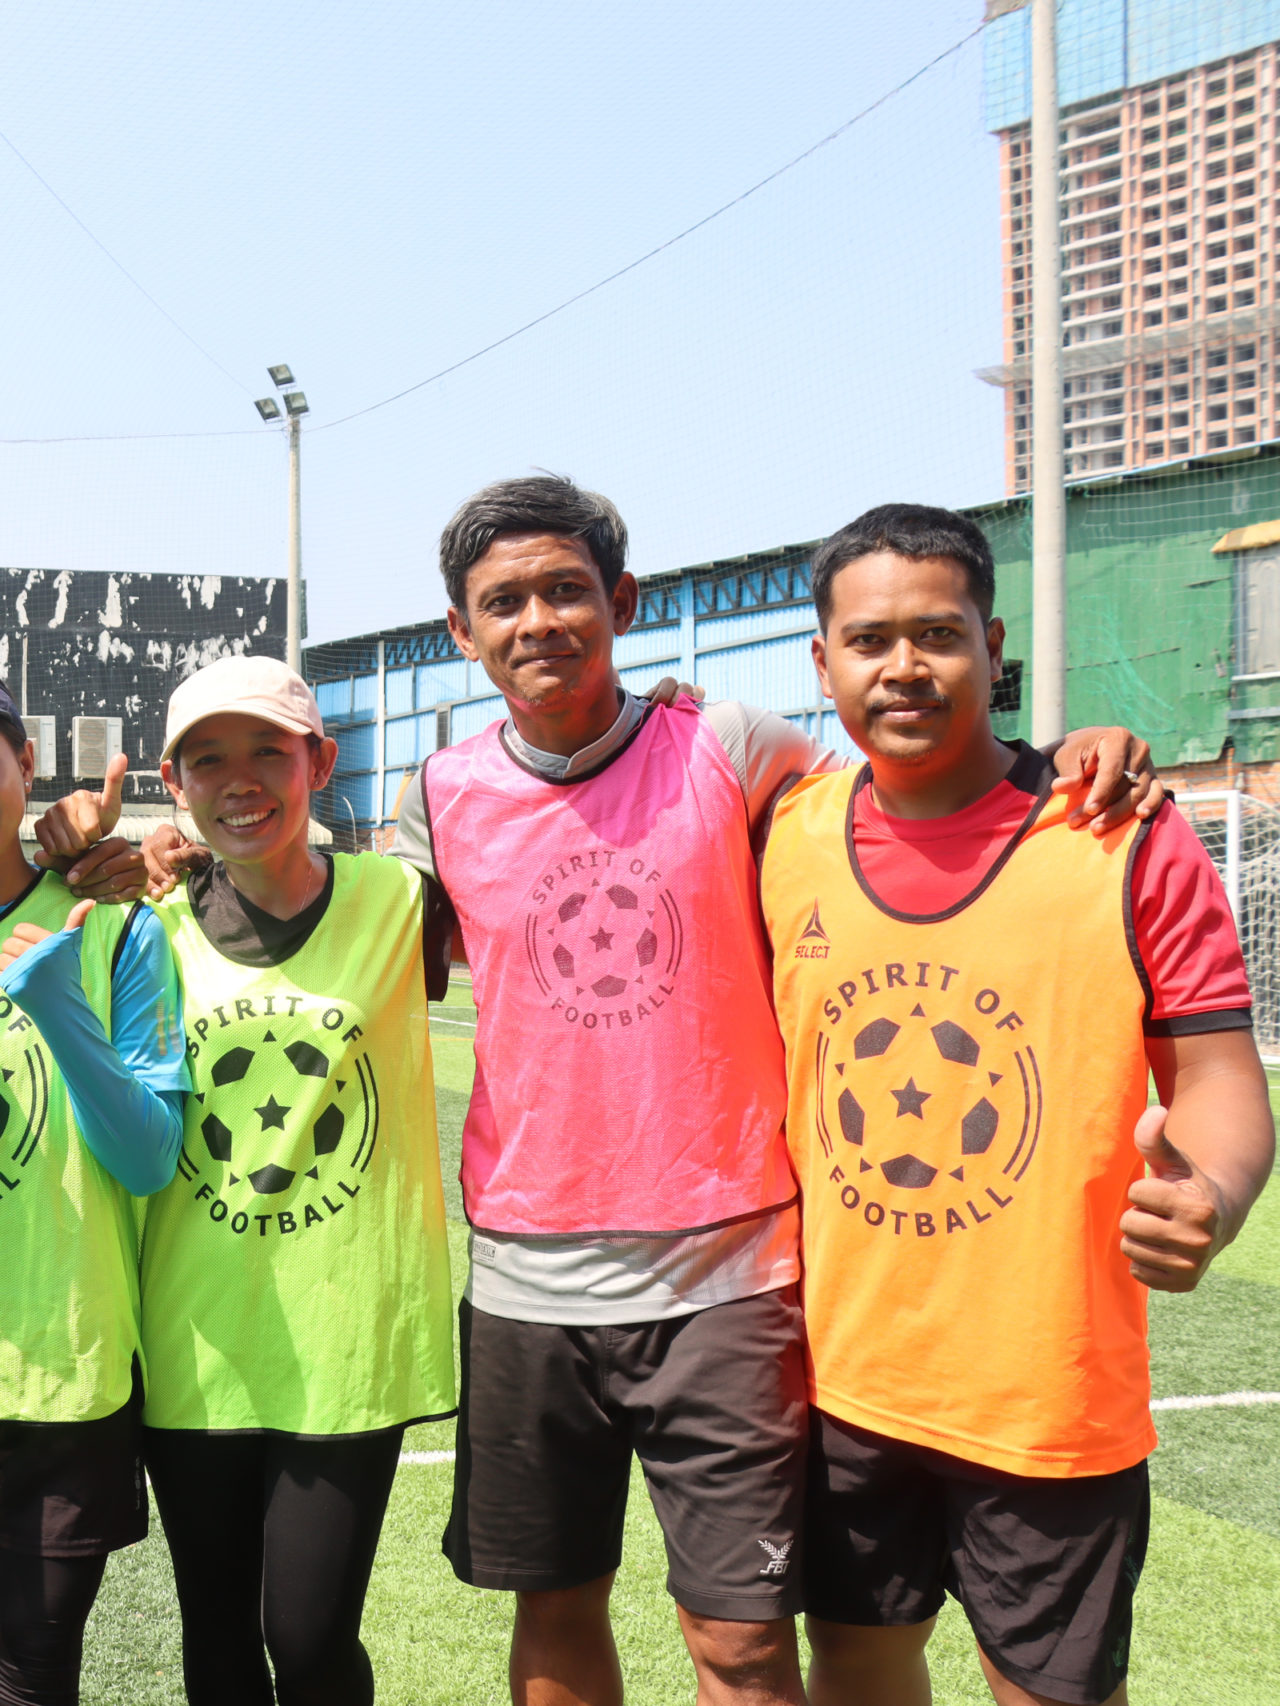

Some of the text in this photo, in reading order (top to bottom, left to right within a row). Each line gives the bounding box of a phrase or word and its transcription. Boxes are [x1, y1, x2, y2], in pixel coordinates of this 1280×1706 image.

[532, 850, 662, 905] SPIRIT OF
[795, 945, 830, 959] SELECT
[550, 984, 674, 1030] FOOTBALL
[823, 961, 1024, 1032] SPIRIT OF
[186, 995, 363, 1059] SPIRIT OF
[195, 1180, 361, 1237] FOOTBALL
[829, 1164, 1013, 1237] FOOTBALL
